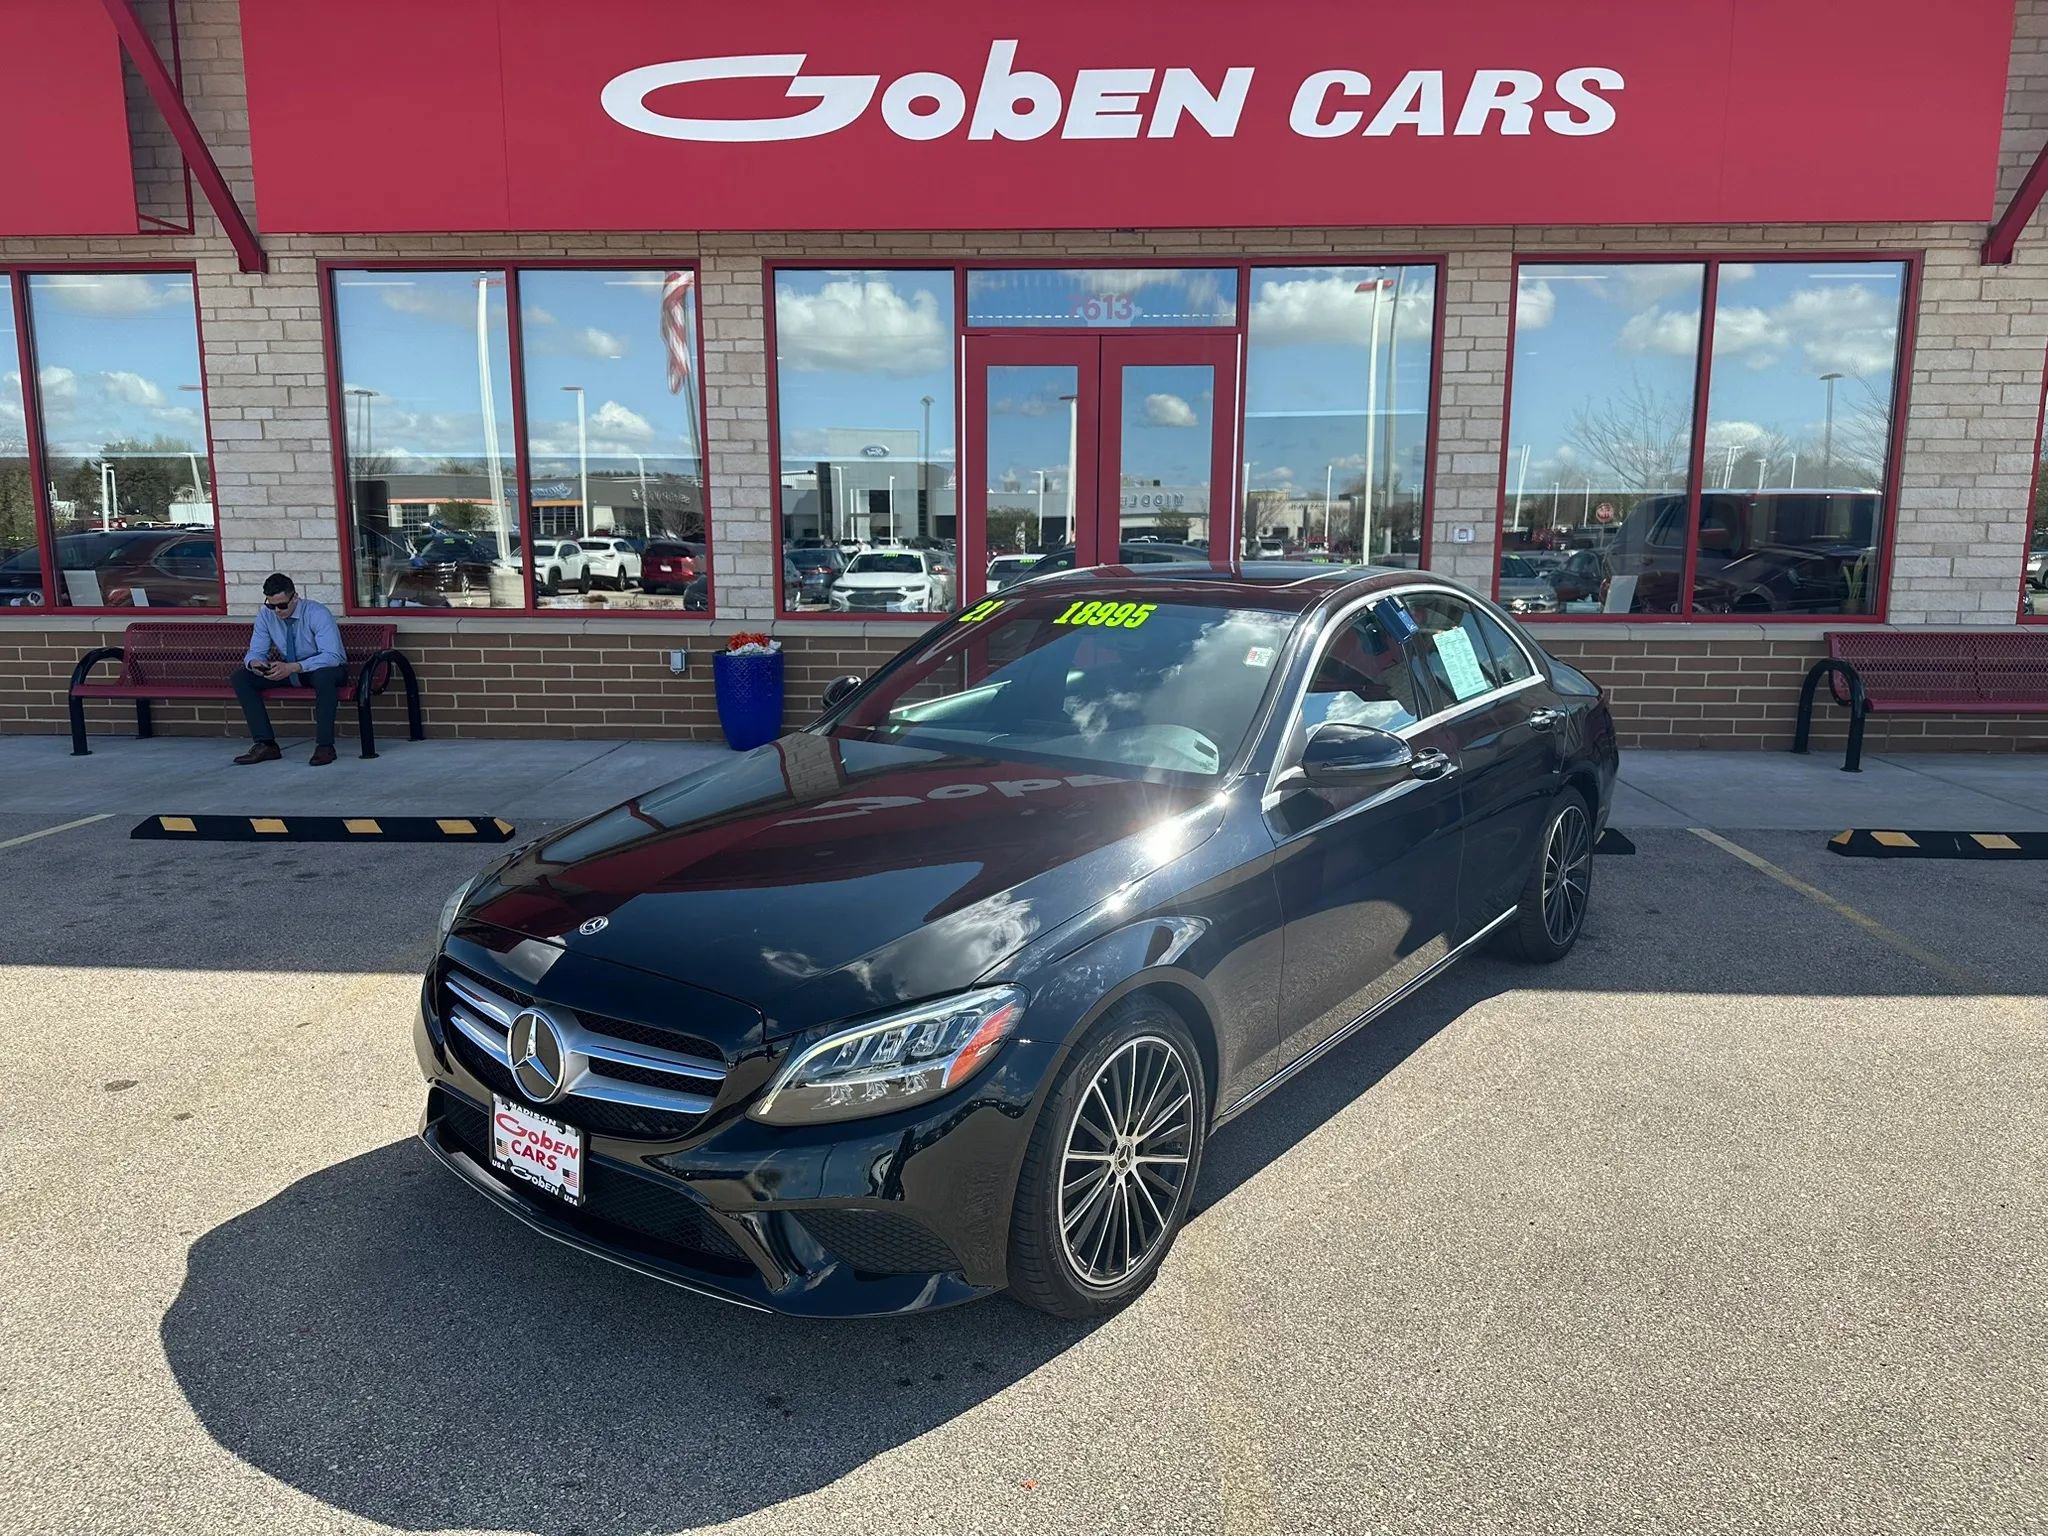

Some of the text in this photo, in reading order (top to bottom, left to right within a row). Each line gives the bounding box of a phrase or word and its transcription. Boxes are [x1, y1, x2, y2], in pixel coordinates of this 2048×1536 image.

[1288, 66, 1626, 139] CARS
[958, 600, 1158, 628] 21 18995
[508, 1101, 557, 1126] MADISON
[491, 1159, 506, 1171] USA
[511, 1139, 558, 1171] CARS
[563, 1193, 578, 1206] USA
